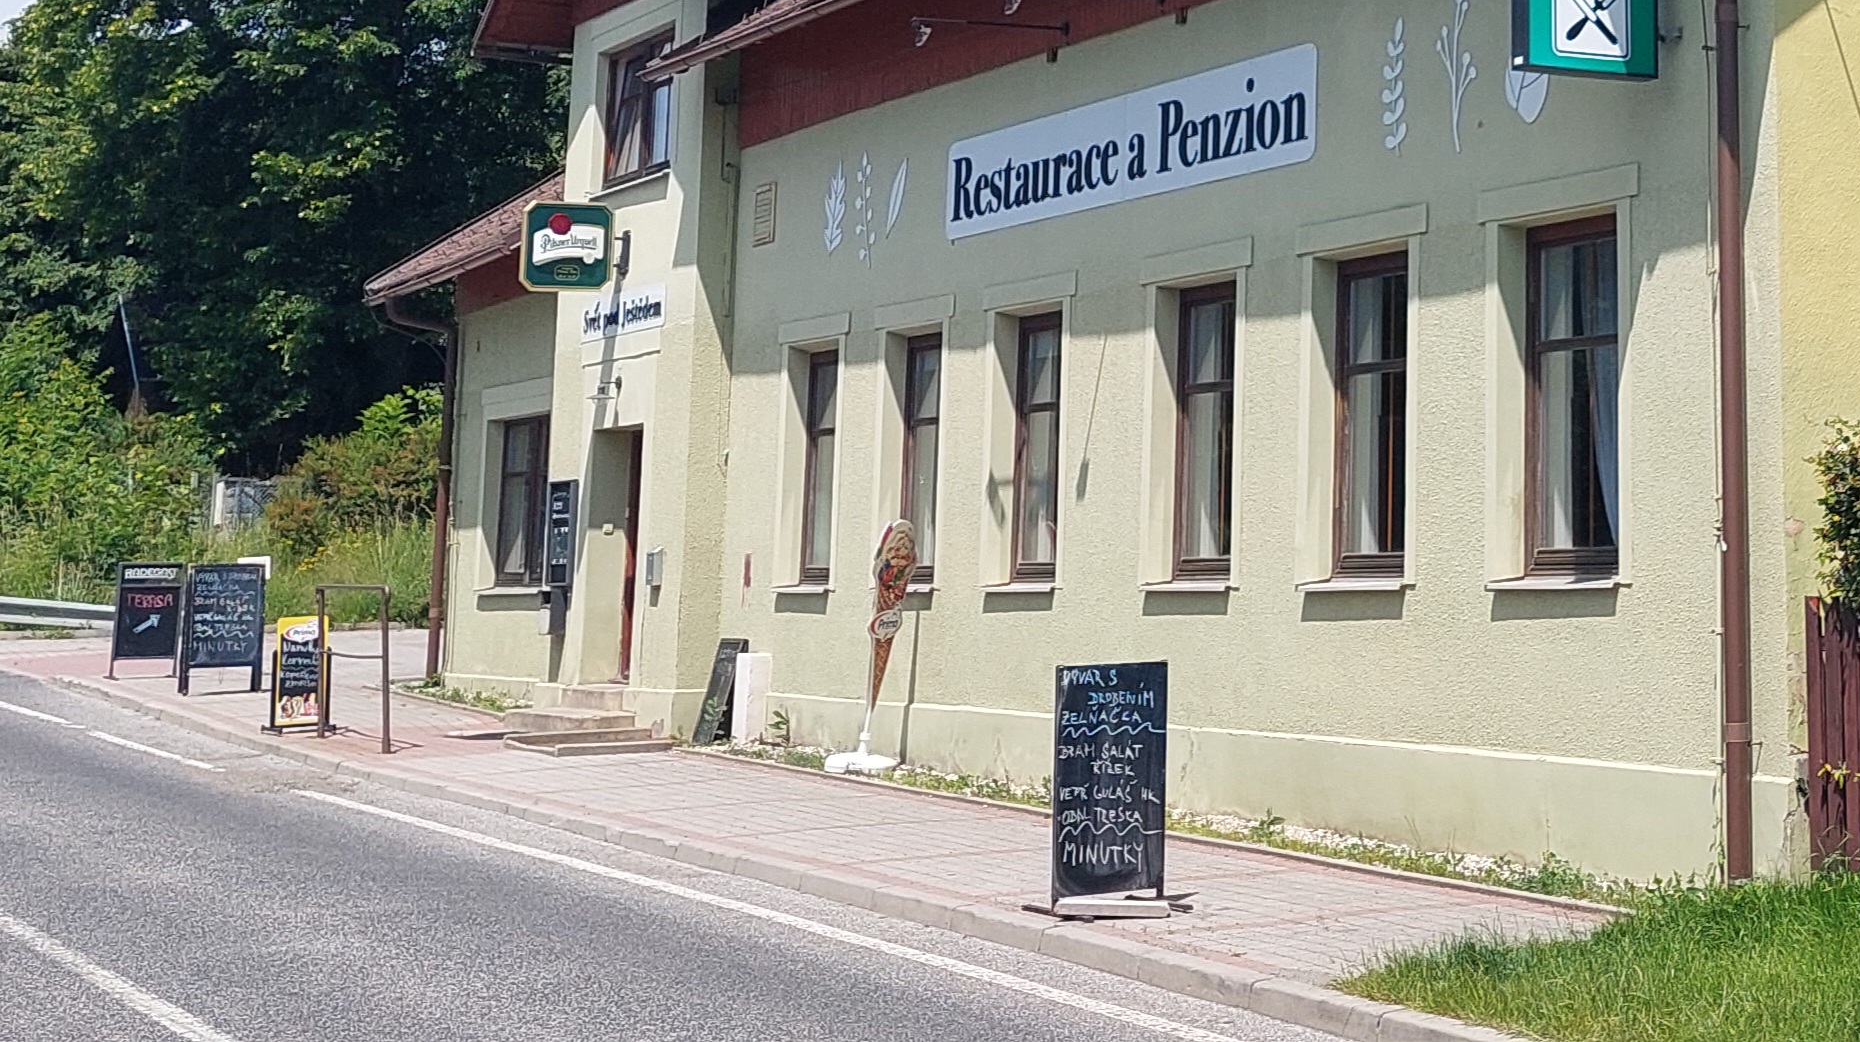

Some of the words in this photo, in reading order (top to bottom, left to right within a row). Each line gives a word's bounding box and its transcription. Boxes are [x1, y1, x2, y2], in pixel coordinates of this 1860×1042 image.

[950, 140, 1119, 222] Restaurace
[1128, 133, 1147, 181] a
[1156, 77, 1308, 174] Penzion
[540, 234, 570, 253] Pilsner
[570, 234, 598, 251] Urquell
[603, 303, 619, 336] pod
[193, 641, 248, 653] MINUTKY
[1108, 669, 1118, 686] S
[1141, 786, 1160, 804] HK
[1062, 840, 1144, 873] MINUTKY
